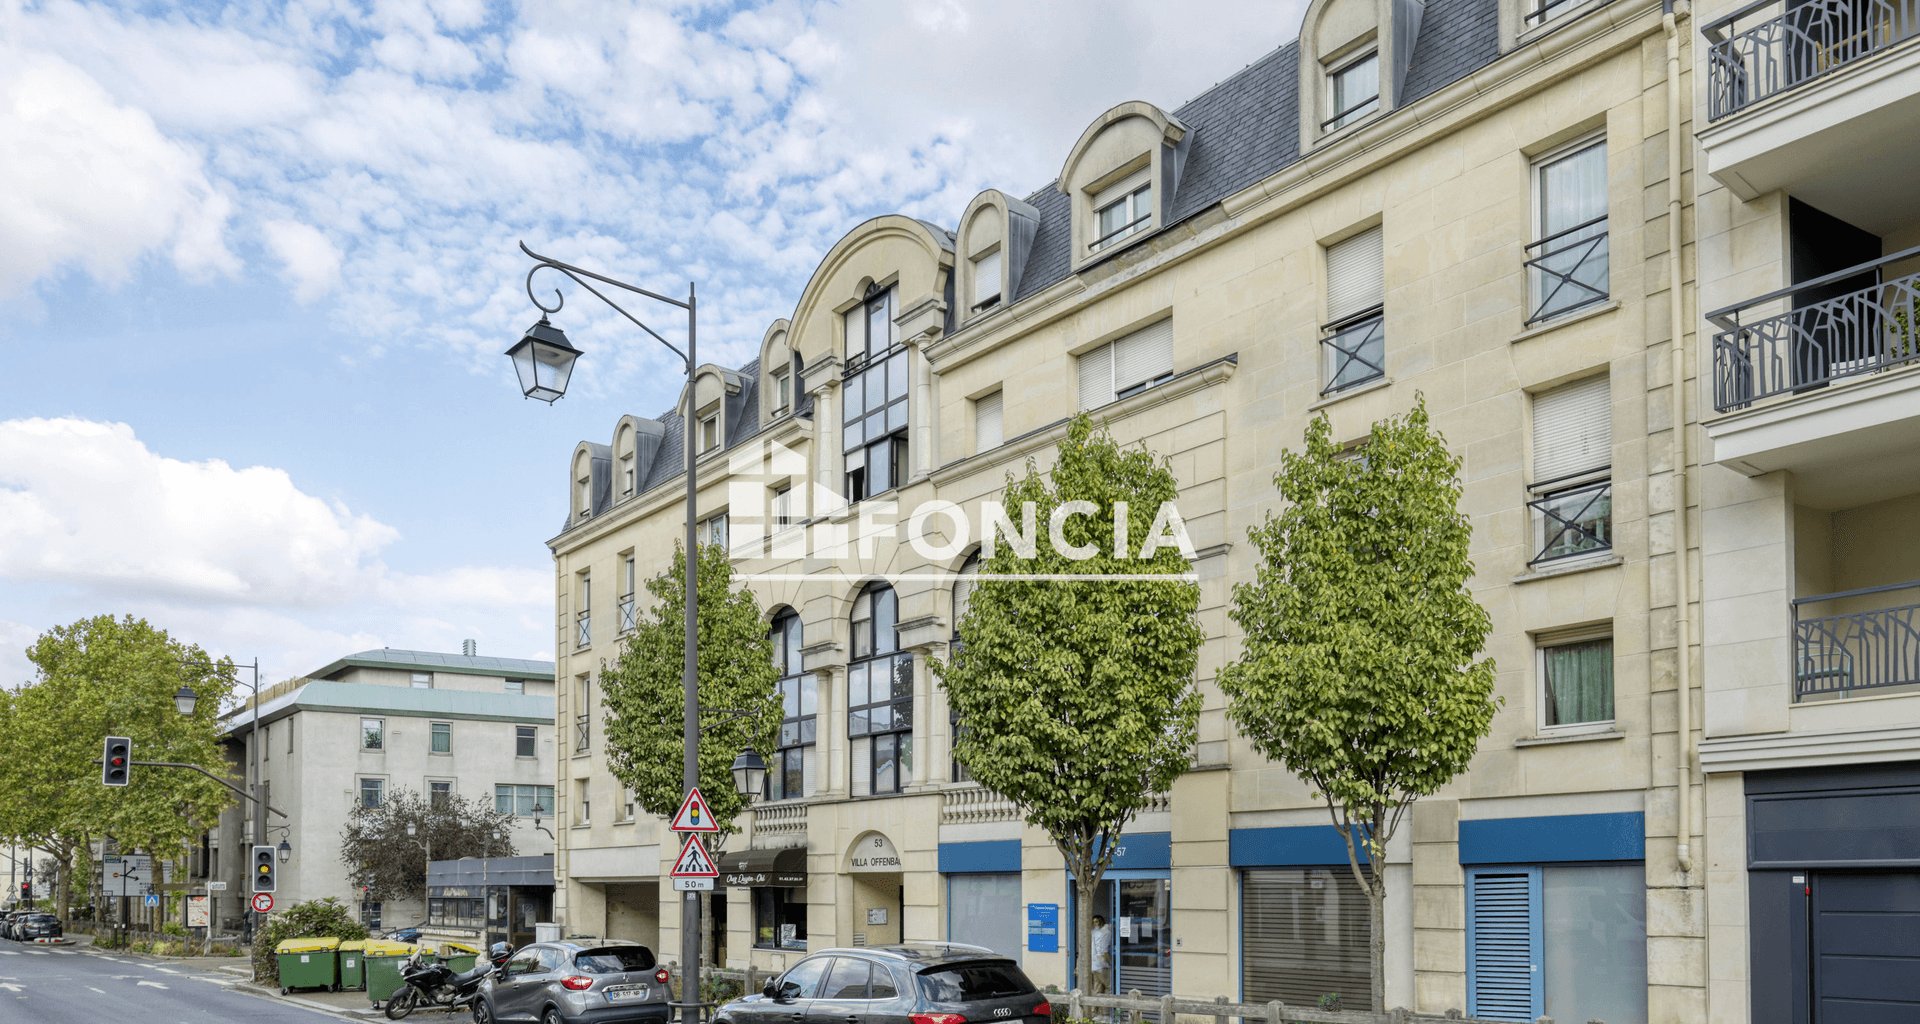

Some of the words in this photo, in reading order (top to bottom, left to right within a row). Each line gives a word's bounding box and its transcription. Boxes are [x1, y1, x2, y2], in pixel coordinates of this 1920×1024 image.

[874, 839, 882, 847] 53
[1105, 847, 1126, 857] 5-57
[851, 858, 868, 867] VILLA
